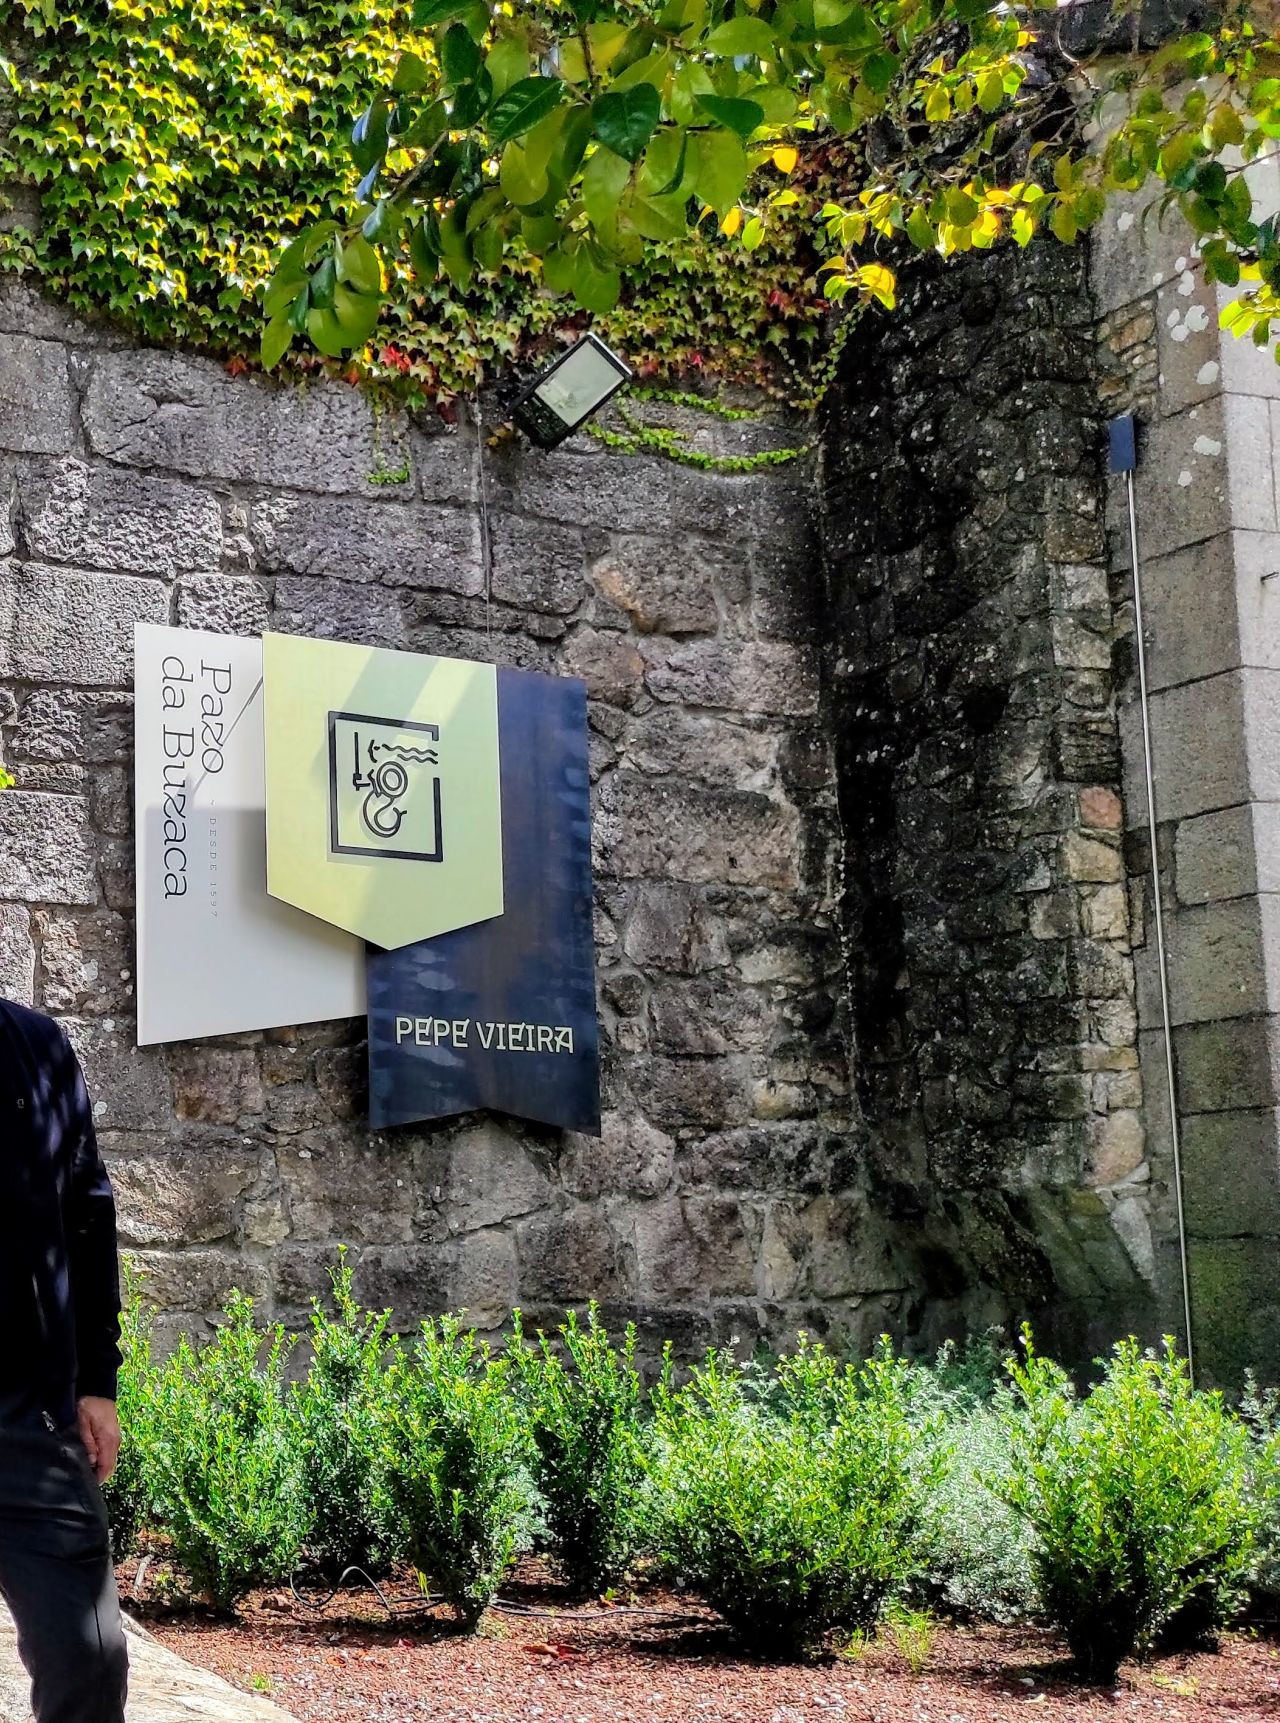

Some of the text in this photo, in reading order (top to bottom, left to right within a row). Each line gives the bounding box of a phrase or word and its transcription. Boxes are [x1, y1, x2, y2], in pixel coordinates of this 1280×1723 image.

[201, 659, 232, 773] Pazo
[162, 656, 195, 899] da Buzaca
[209, 817, 217, 871] DESDE
[395, 1015, 574, 1054] PEPE VIEIRA
